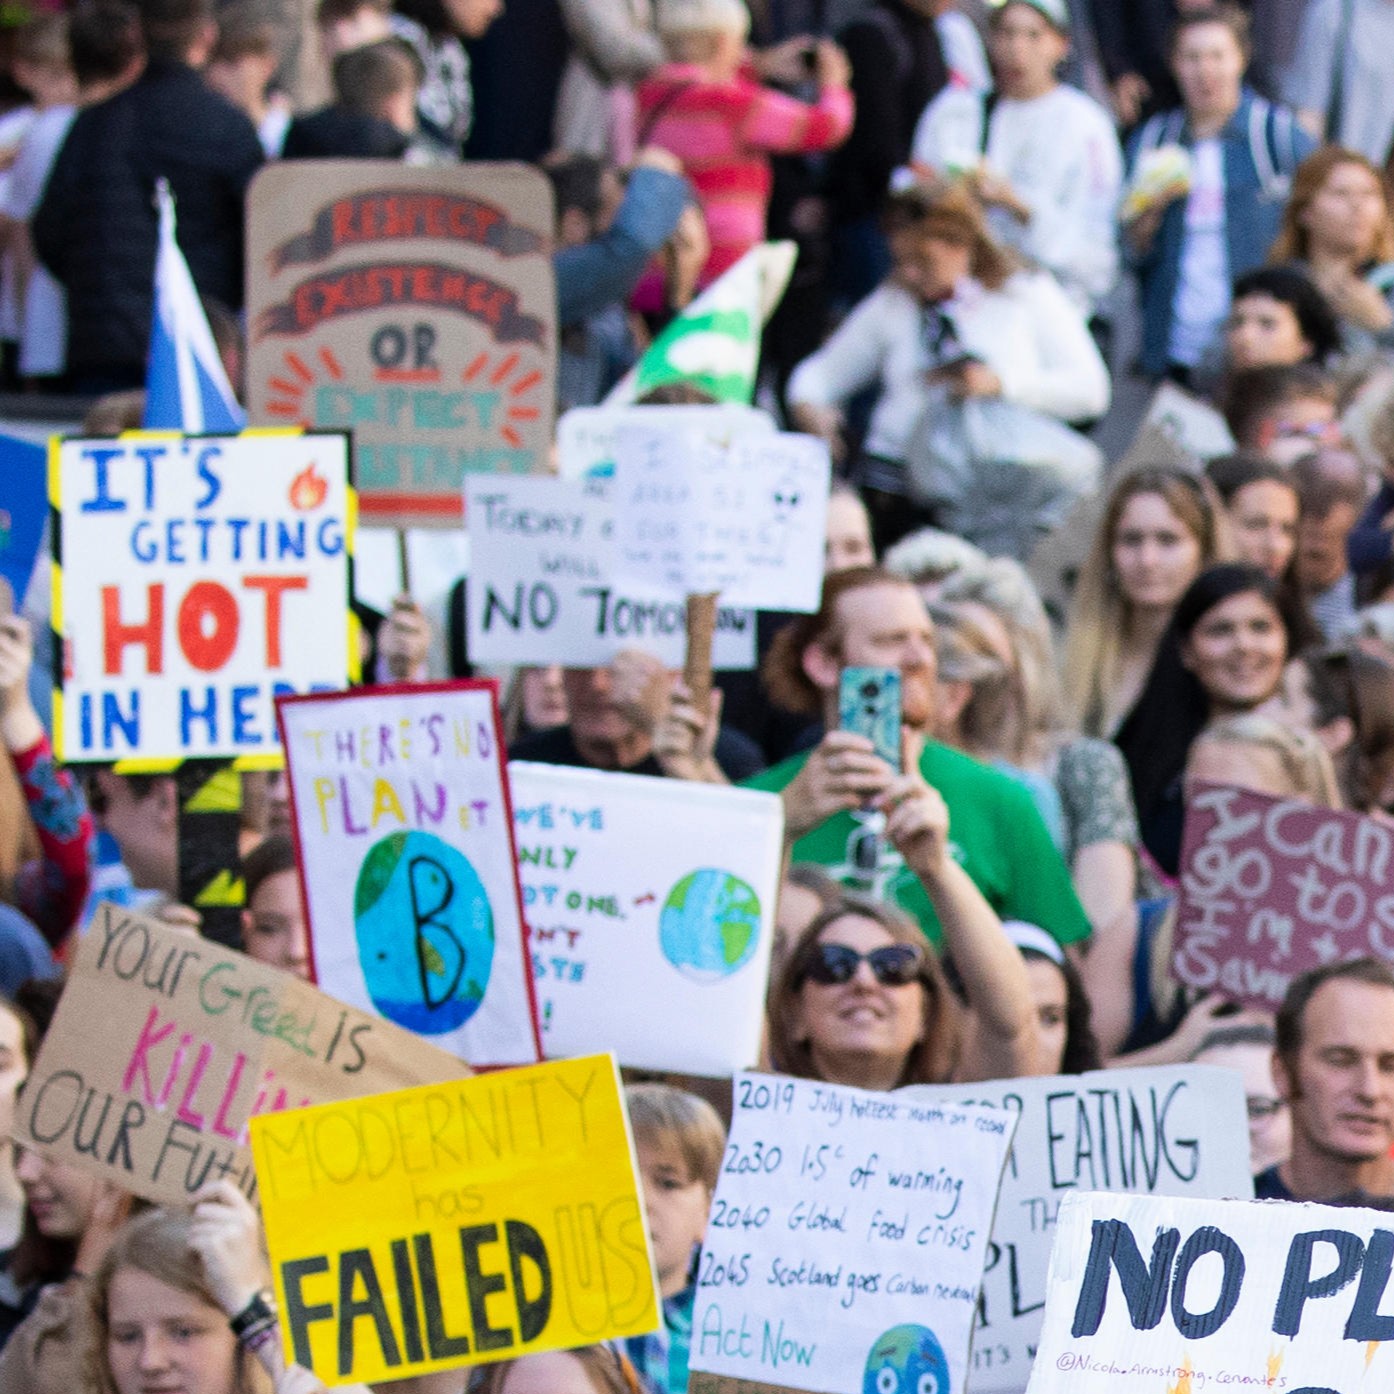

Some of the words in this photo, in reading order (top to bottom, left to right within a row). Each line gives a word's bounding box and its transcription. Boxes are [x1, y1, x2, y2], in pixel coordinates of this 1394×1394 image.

[369, 322, 437, 369] OR
[80, 446, 222, 513] IT'S
[129, 518, 345, 563] GETTING
[101, 575, 308, 676] HOT
[482, 580, 558, 634] NO
[80, 690, 140, 749] IN
[179, 683, 340, 747] HE
[453, 716, 492, 763] NO
[312, 775, 490, 836] PLANET
[518, 845, 577, 870] NLY
[522, 884, 558, 906] OT
[407, 855, 466, 1011] B
[325, 1009, 373, 1074] IS
[28, 1069, 148, 1173] OUR
[258, 1064, 598, 1198] MODERNITY
[739, 1079, 798, 1113] 2019
[808, 1088, 844, 1128] July
[1045, 1079, 1200, 1191] EATING
[411, 1180, 488, 1221] has
[850, 1152, 880, 1189] of
[887, 1163, 965, 1221] warming
[711, 1199, 771, 1232] 2040
[787, 1200, 848, 1233] Global
[916, 1225, 977, 1252] crisis
[280, 1218, 555, 1378] FAILED
[553, 1194, 658, 1338] US
[701, 1251, 753, 1289] 2045
[766, 1256, 843, 1289] Scotland
[841, 1272, 881, 1309] goes
[1072, 1218, 1246, 1340] NO
[699, 1302, 752, 1362] Act
[761, 1317, 817, 1371] Now
